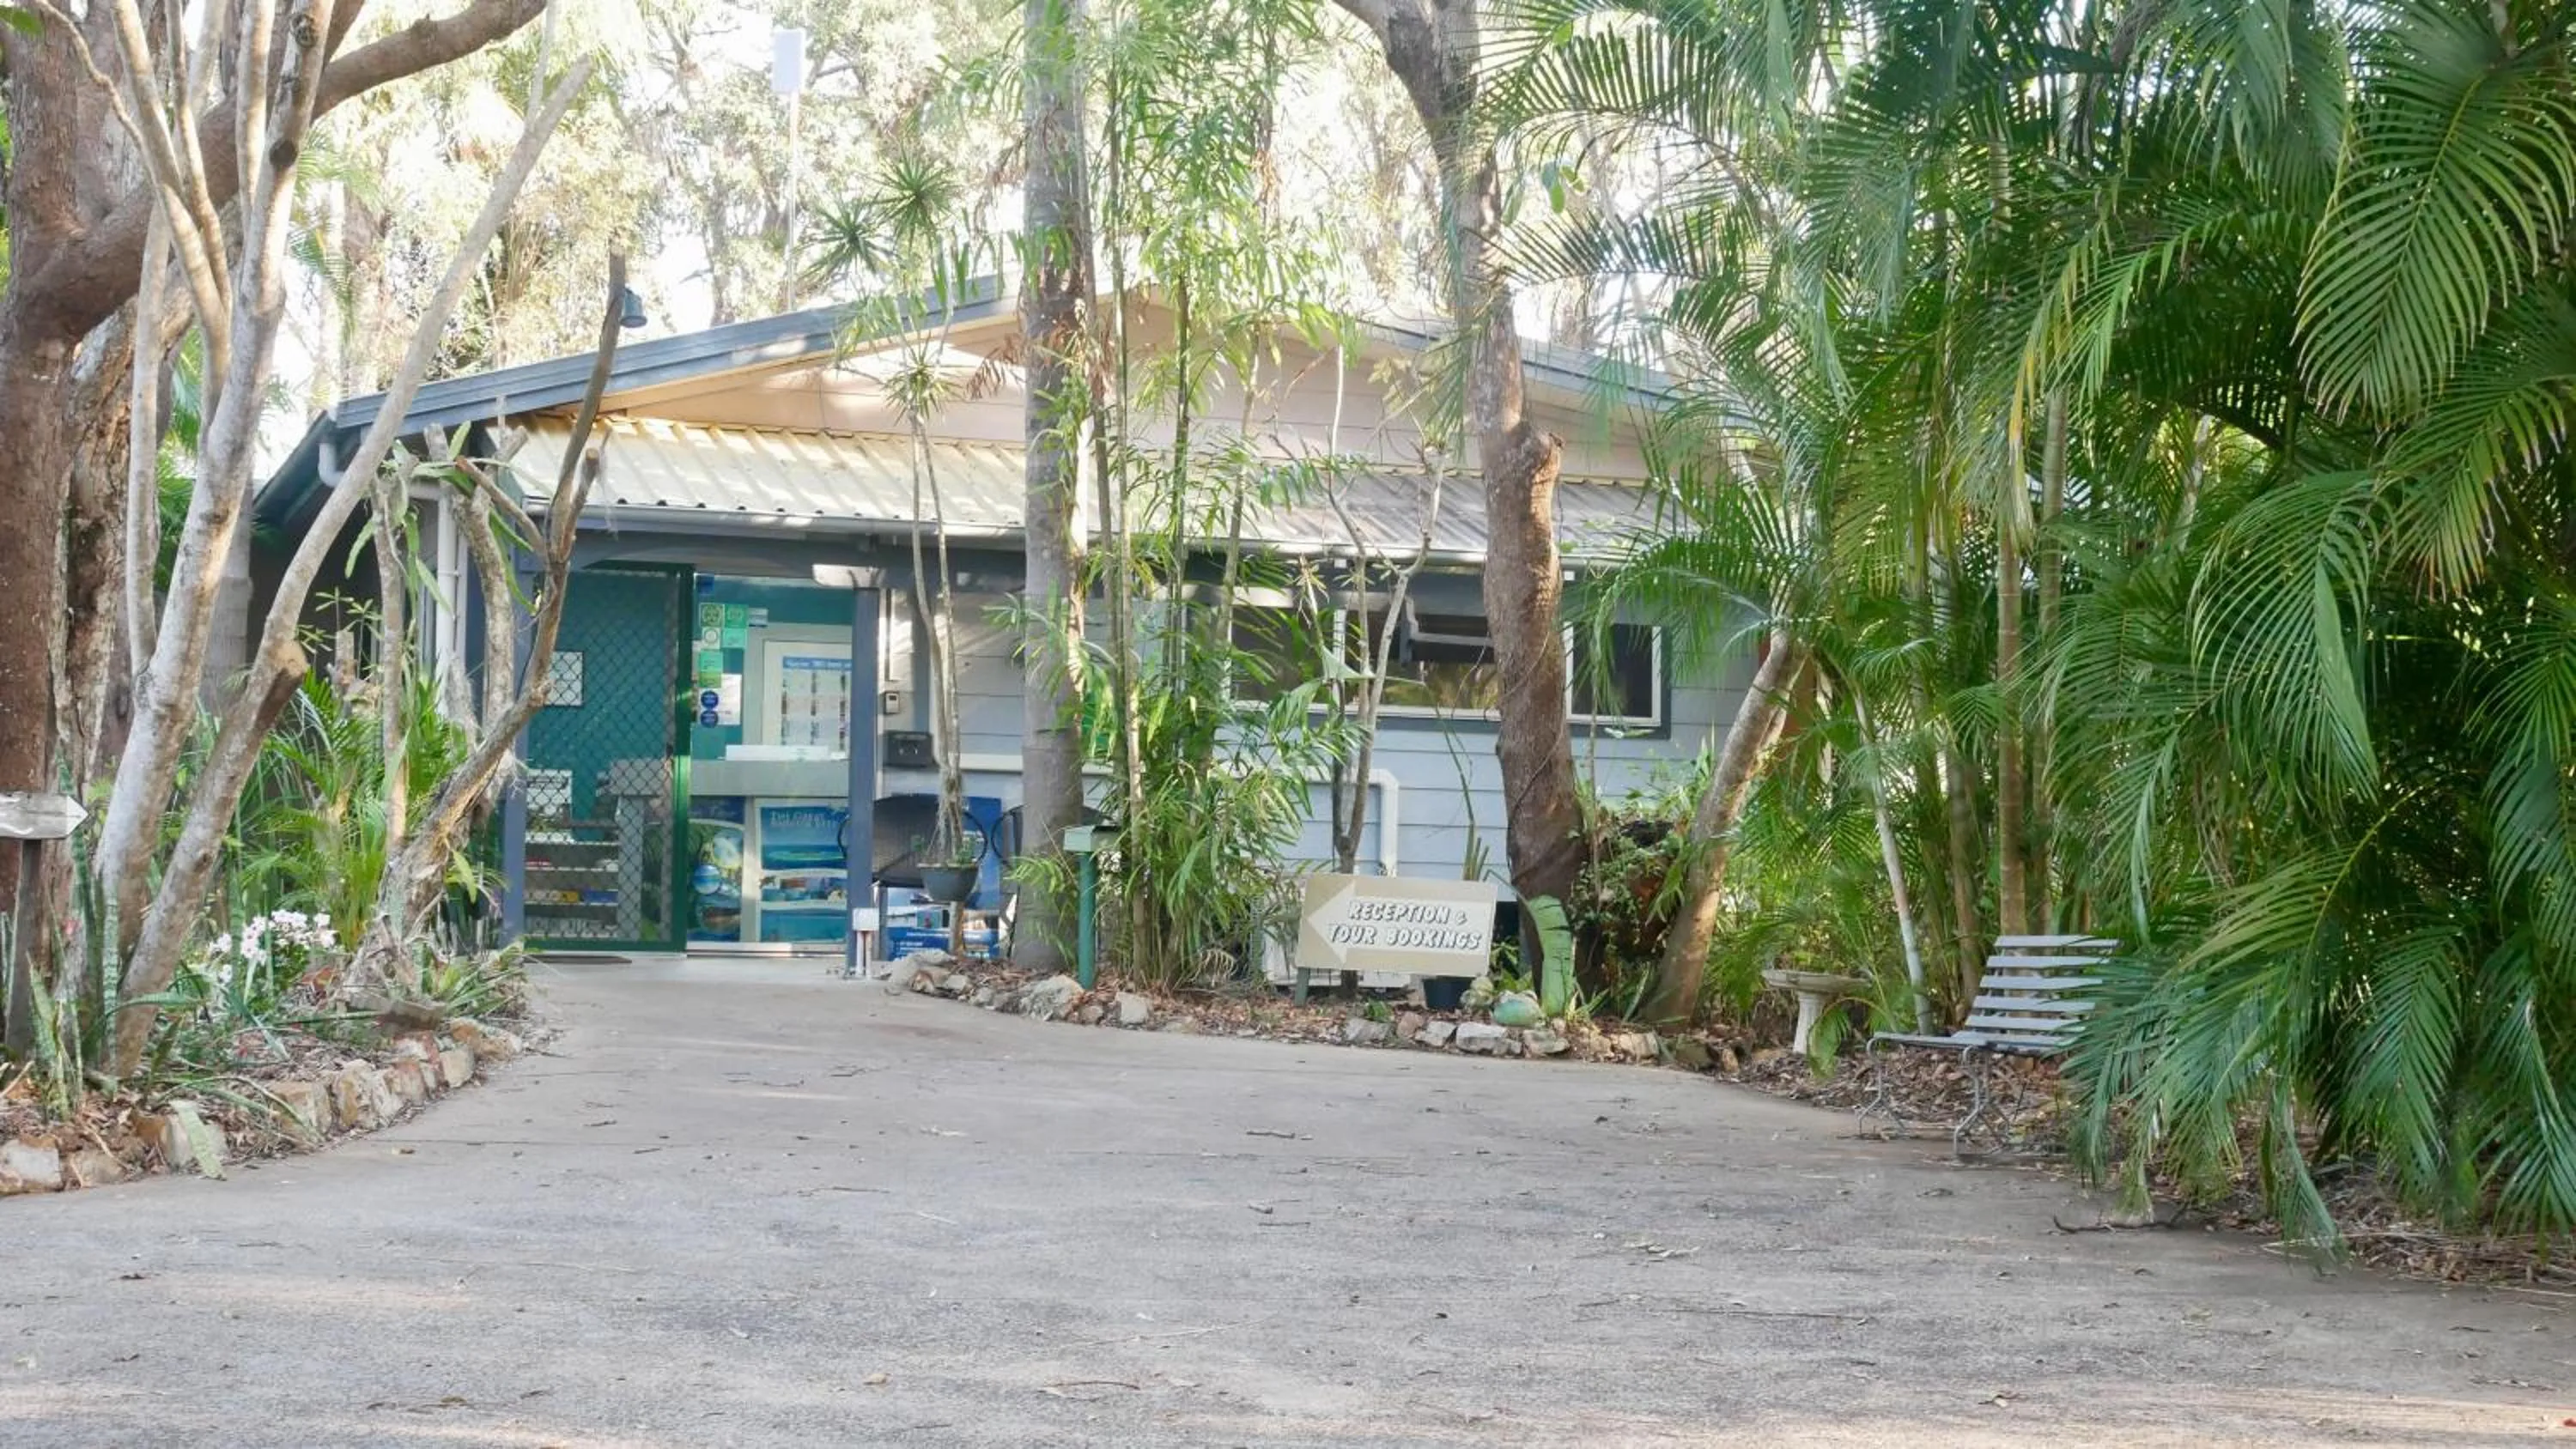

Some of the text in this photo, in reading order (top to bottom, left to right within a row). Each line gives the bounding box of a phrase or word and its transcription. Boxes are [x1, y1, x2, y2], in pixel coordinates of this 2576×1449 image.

[1349, 901, 1450, 924] RECEPTION
[1329, 923, 1481, 949] TOUR BOOKINGS
